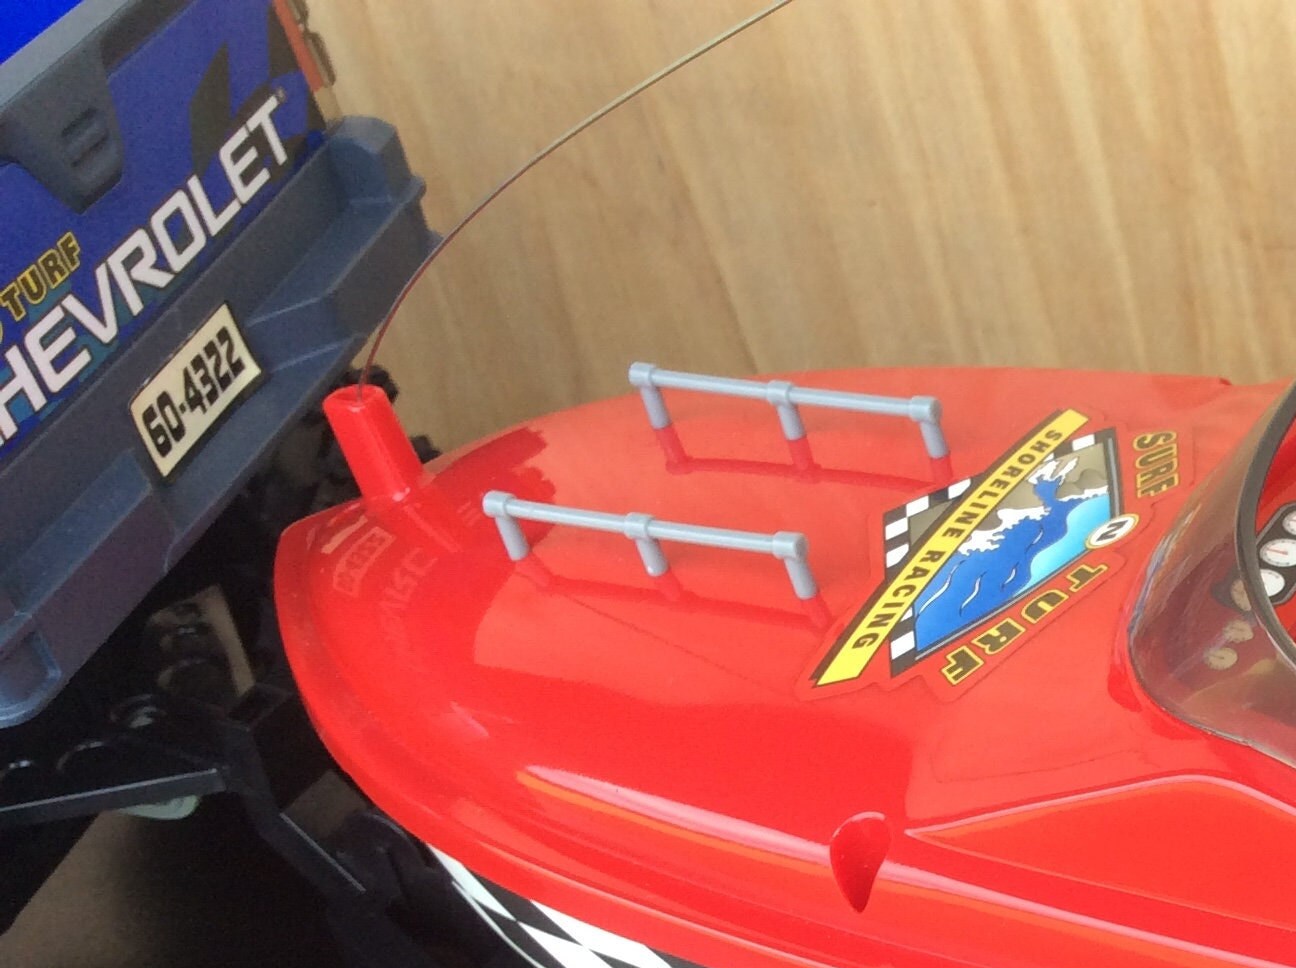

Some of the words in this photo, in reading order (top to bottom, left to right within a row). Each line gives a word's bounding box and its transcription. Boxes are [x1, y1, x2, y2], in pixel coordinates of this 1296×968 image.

[0, 96, 287, 446] HEVROLET
[0, 231, 81, 321] TURF
[943, 429, 1064, 538] SHORELINE
[1133, 430, 1181, 499] SURF
[851, 549, 941, 650] RACING
[941, 563, 1108, 686] TURF
